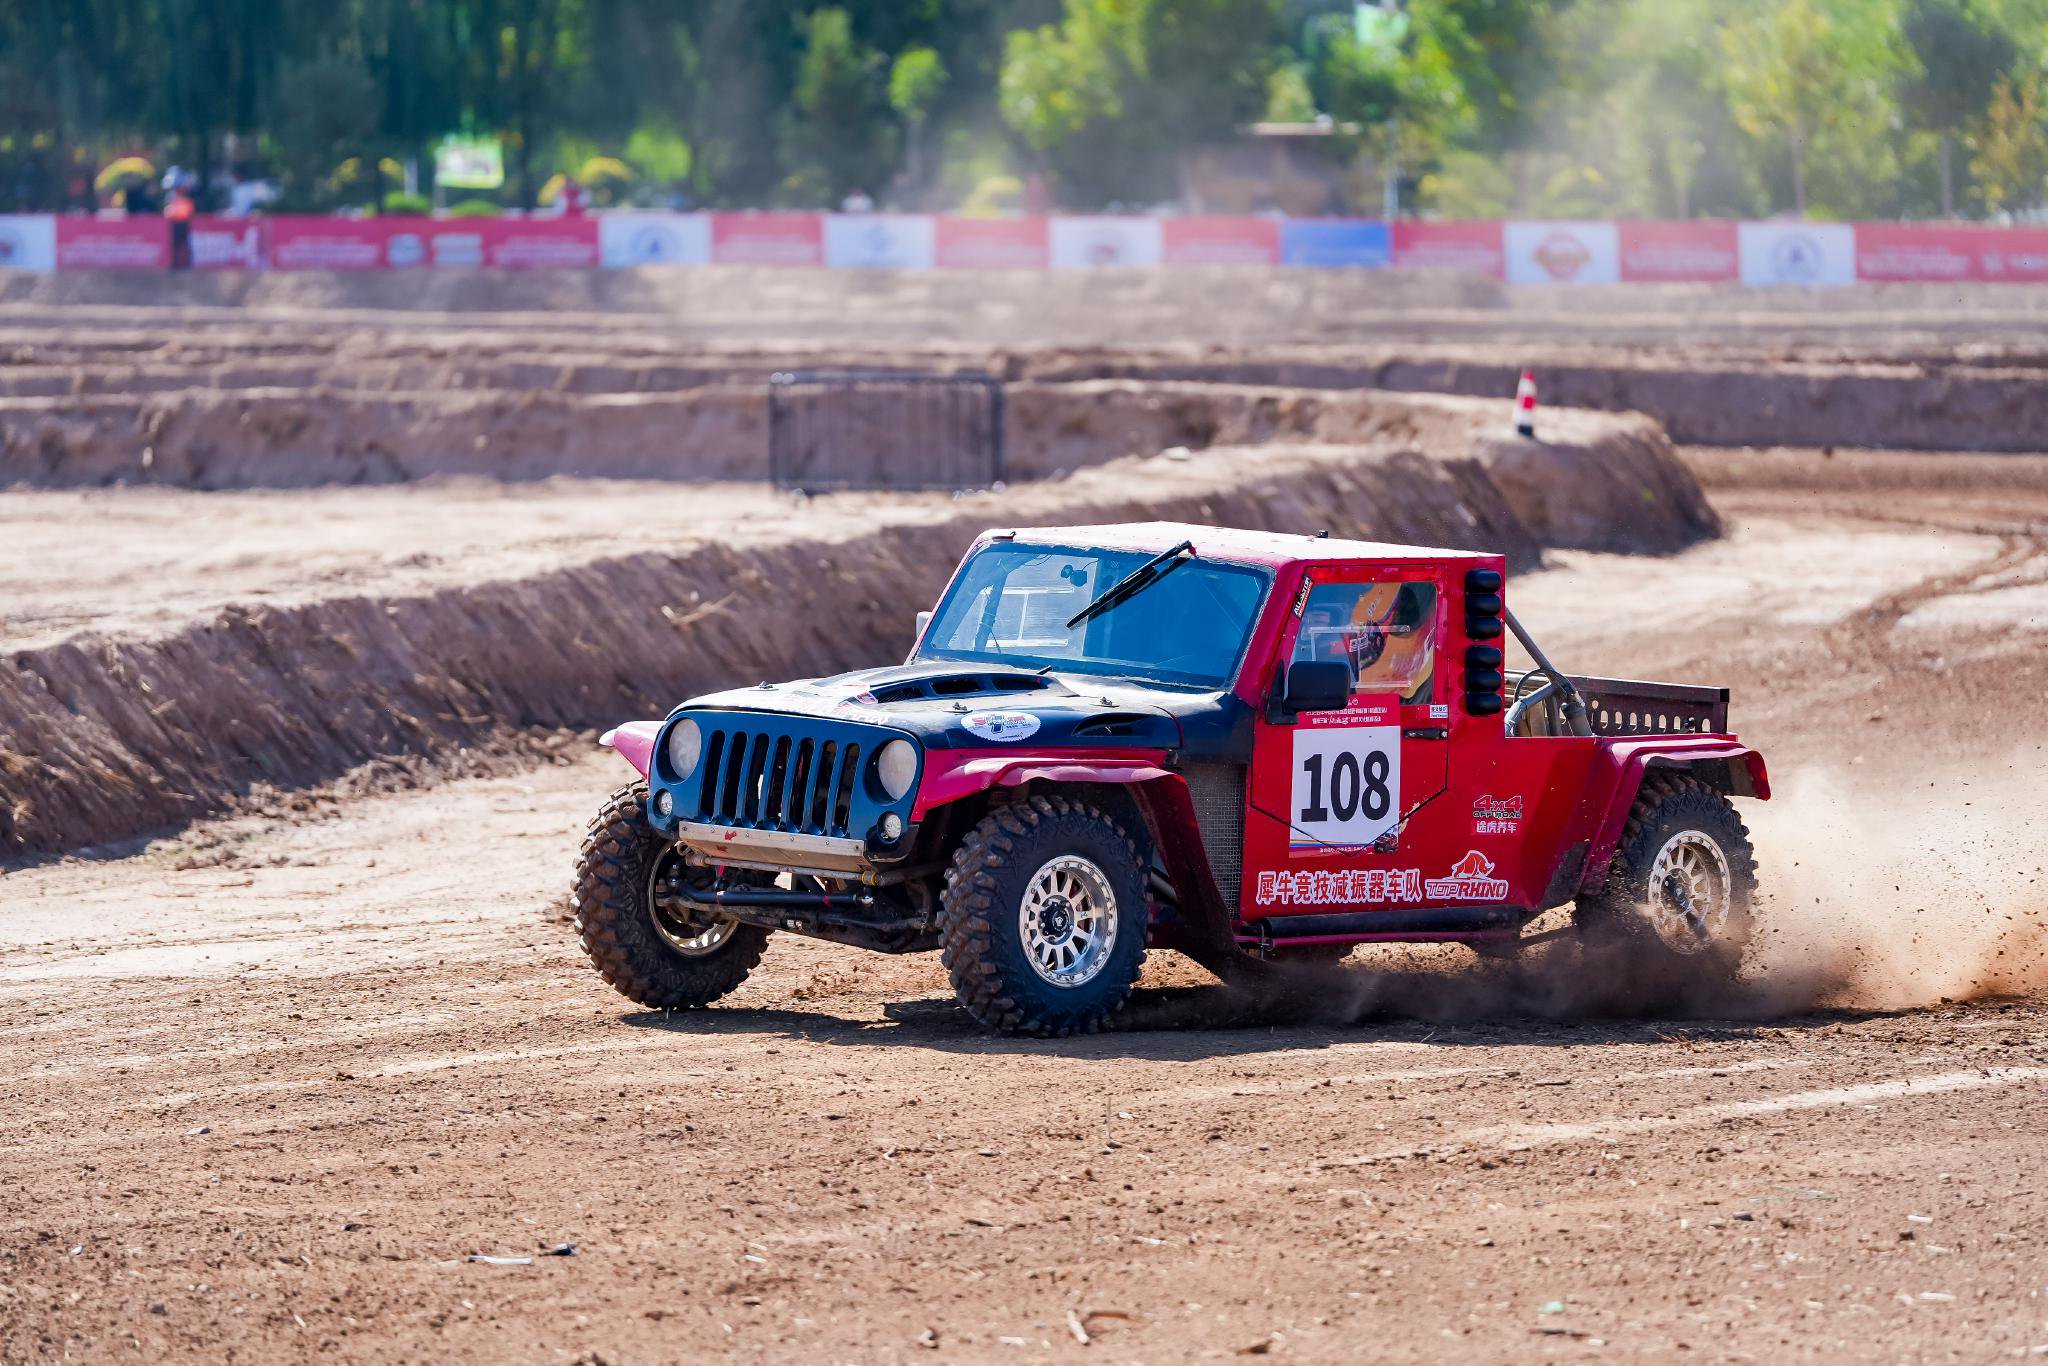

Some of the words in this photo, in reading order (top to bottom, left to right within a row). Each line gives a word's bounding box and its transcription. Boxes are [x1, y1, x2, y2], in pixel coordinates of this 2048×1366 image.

[1301, 750, 1390, 822] 108
[1477, 820, 1517, 833] 途虎养车
[1494, 811, 1521, 819] ROAD
[1256, 869, 1422, 904] 犀牛竞技减振器车队
